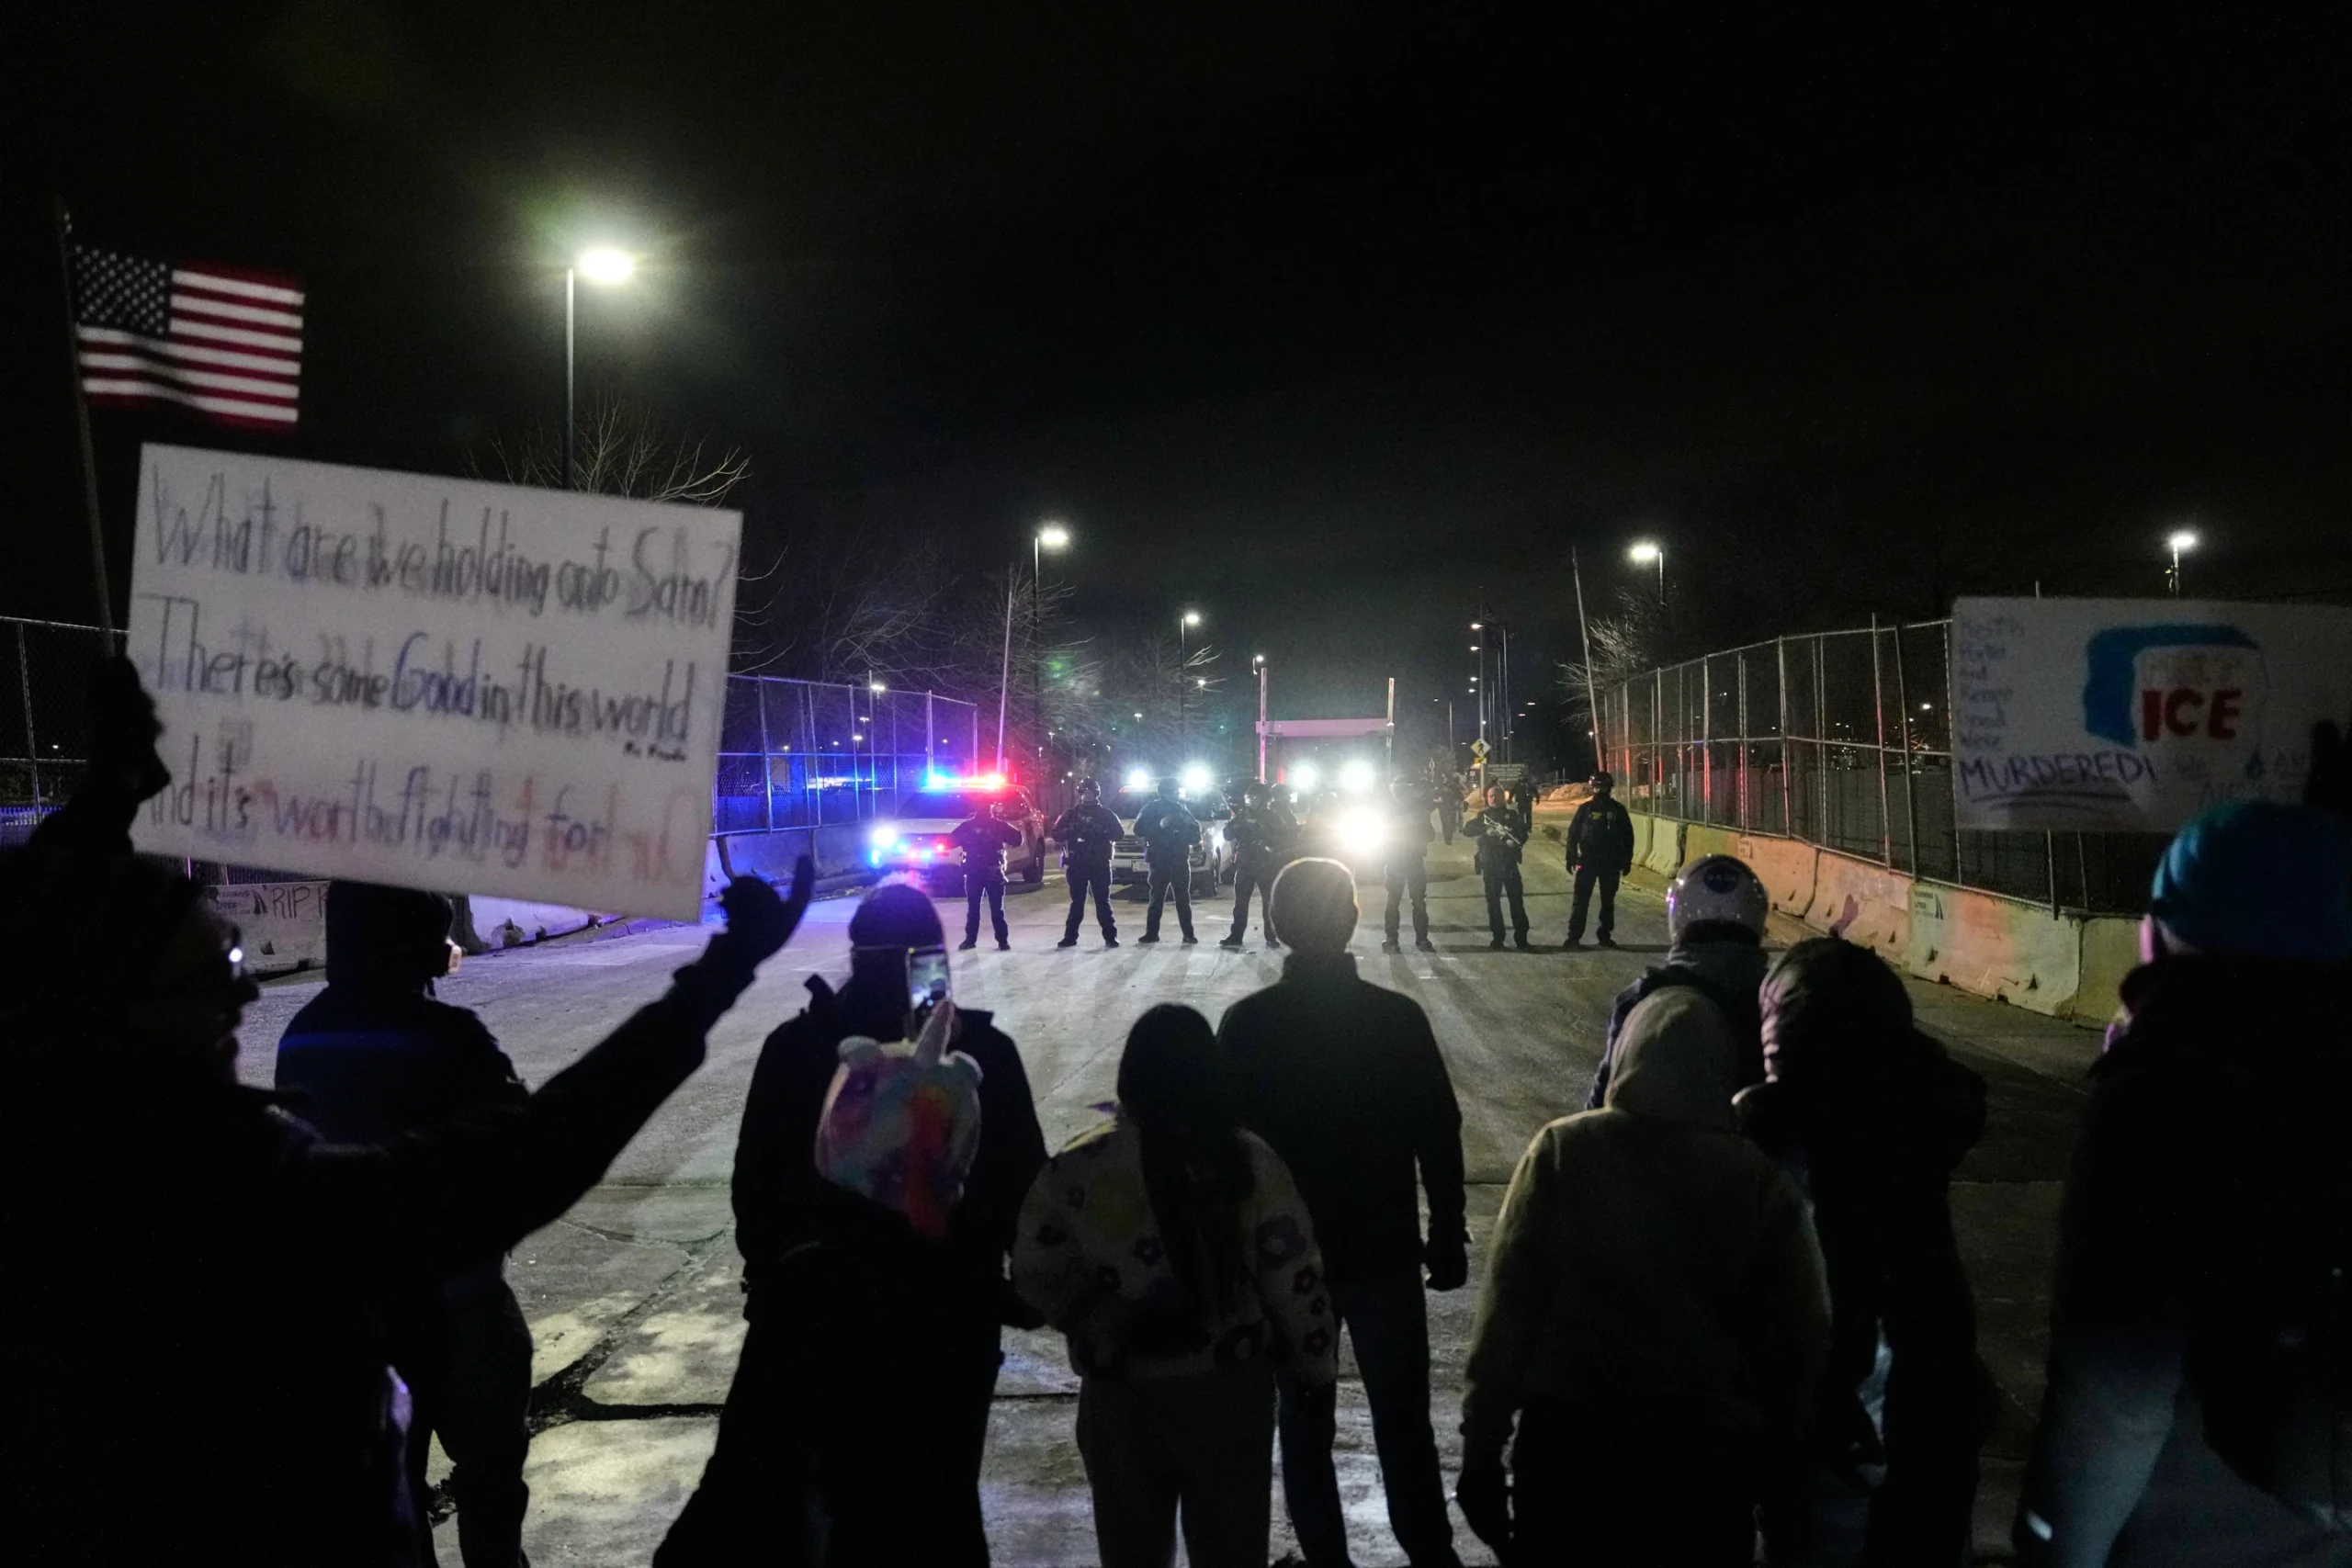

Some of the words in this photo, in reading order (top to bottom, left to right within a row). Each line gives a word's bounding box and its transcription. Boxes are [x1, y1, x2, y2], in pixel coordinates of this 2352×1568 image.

[152, 463, 276, 575] What
[284, 522, 356, 584] are
[433, 497, 550, 617] holding
[138, 593, 296, 702] There's
[313, 658, 390, 709] some
[517, 641, 581, 732] this
[592, 659, 695, 741] world
[2143, 687, 2243, 742] ICE
[150, 734, 199, 826] nd
[272, 886, 311, 919] RIP
